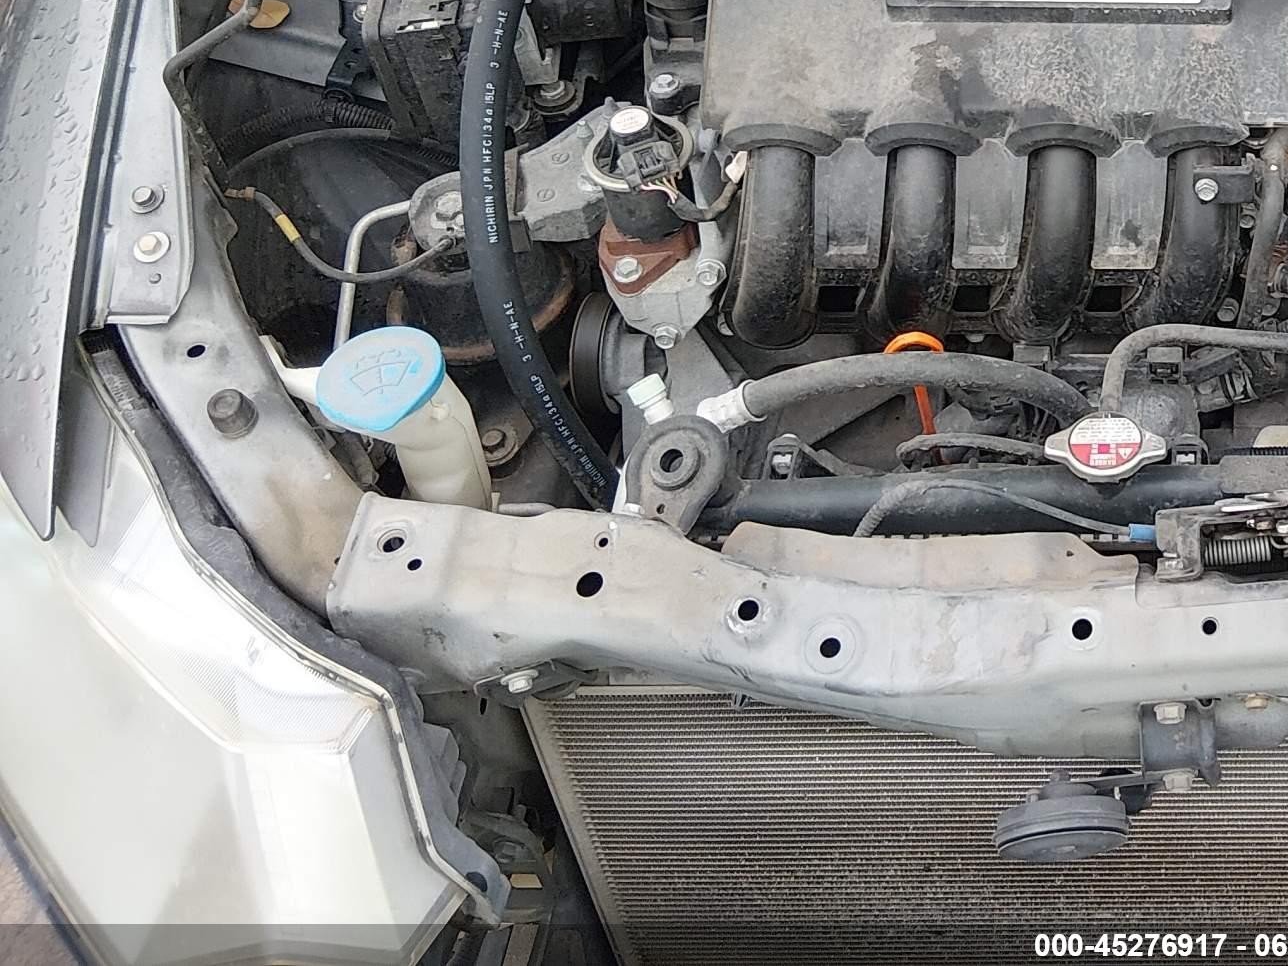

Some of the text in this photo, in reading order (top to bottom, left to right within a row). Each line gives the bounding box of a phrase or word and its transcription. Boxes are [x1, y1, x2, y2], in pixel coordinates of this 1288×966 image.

[484, 82, 496, 105] 15LP
[481, 108, 494, 163] HFC134a
[482, 167, 494, 191] JPN
[484, 195, 499, 244] NICHIRIN
[566, 436, 584, 455] JPN
